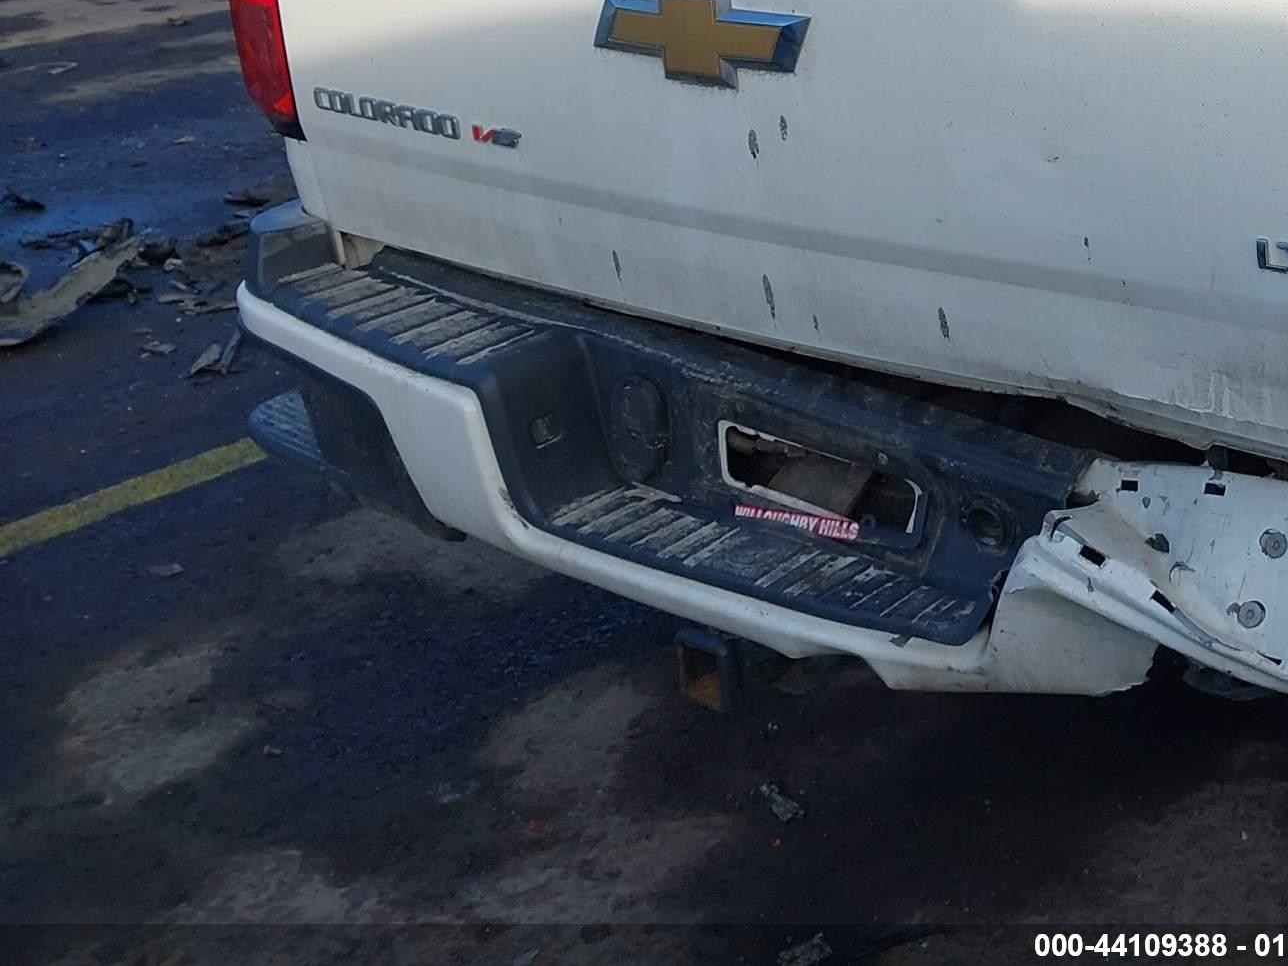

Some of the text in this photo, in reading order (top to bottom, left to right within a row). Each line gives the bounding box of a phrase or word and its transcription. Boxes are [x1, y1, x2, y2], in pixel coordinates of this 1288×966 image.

[313, 86, 523, 149] COLORADO V6
[817, 520, 860, 541] HILLS
